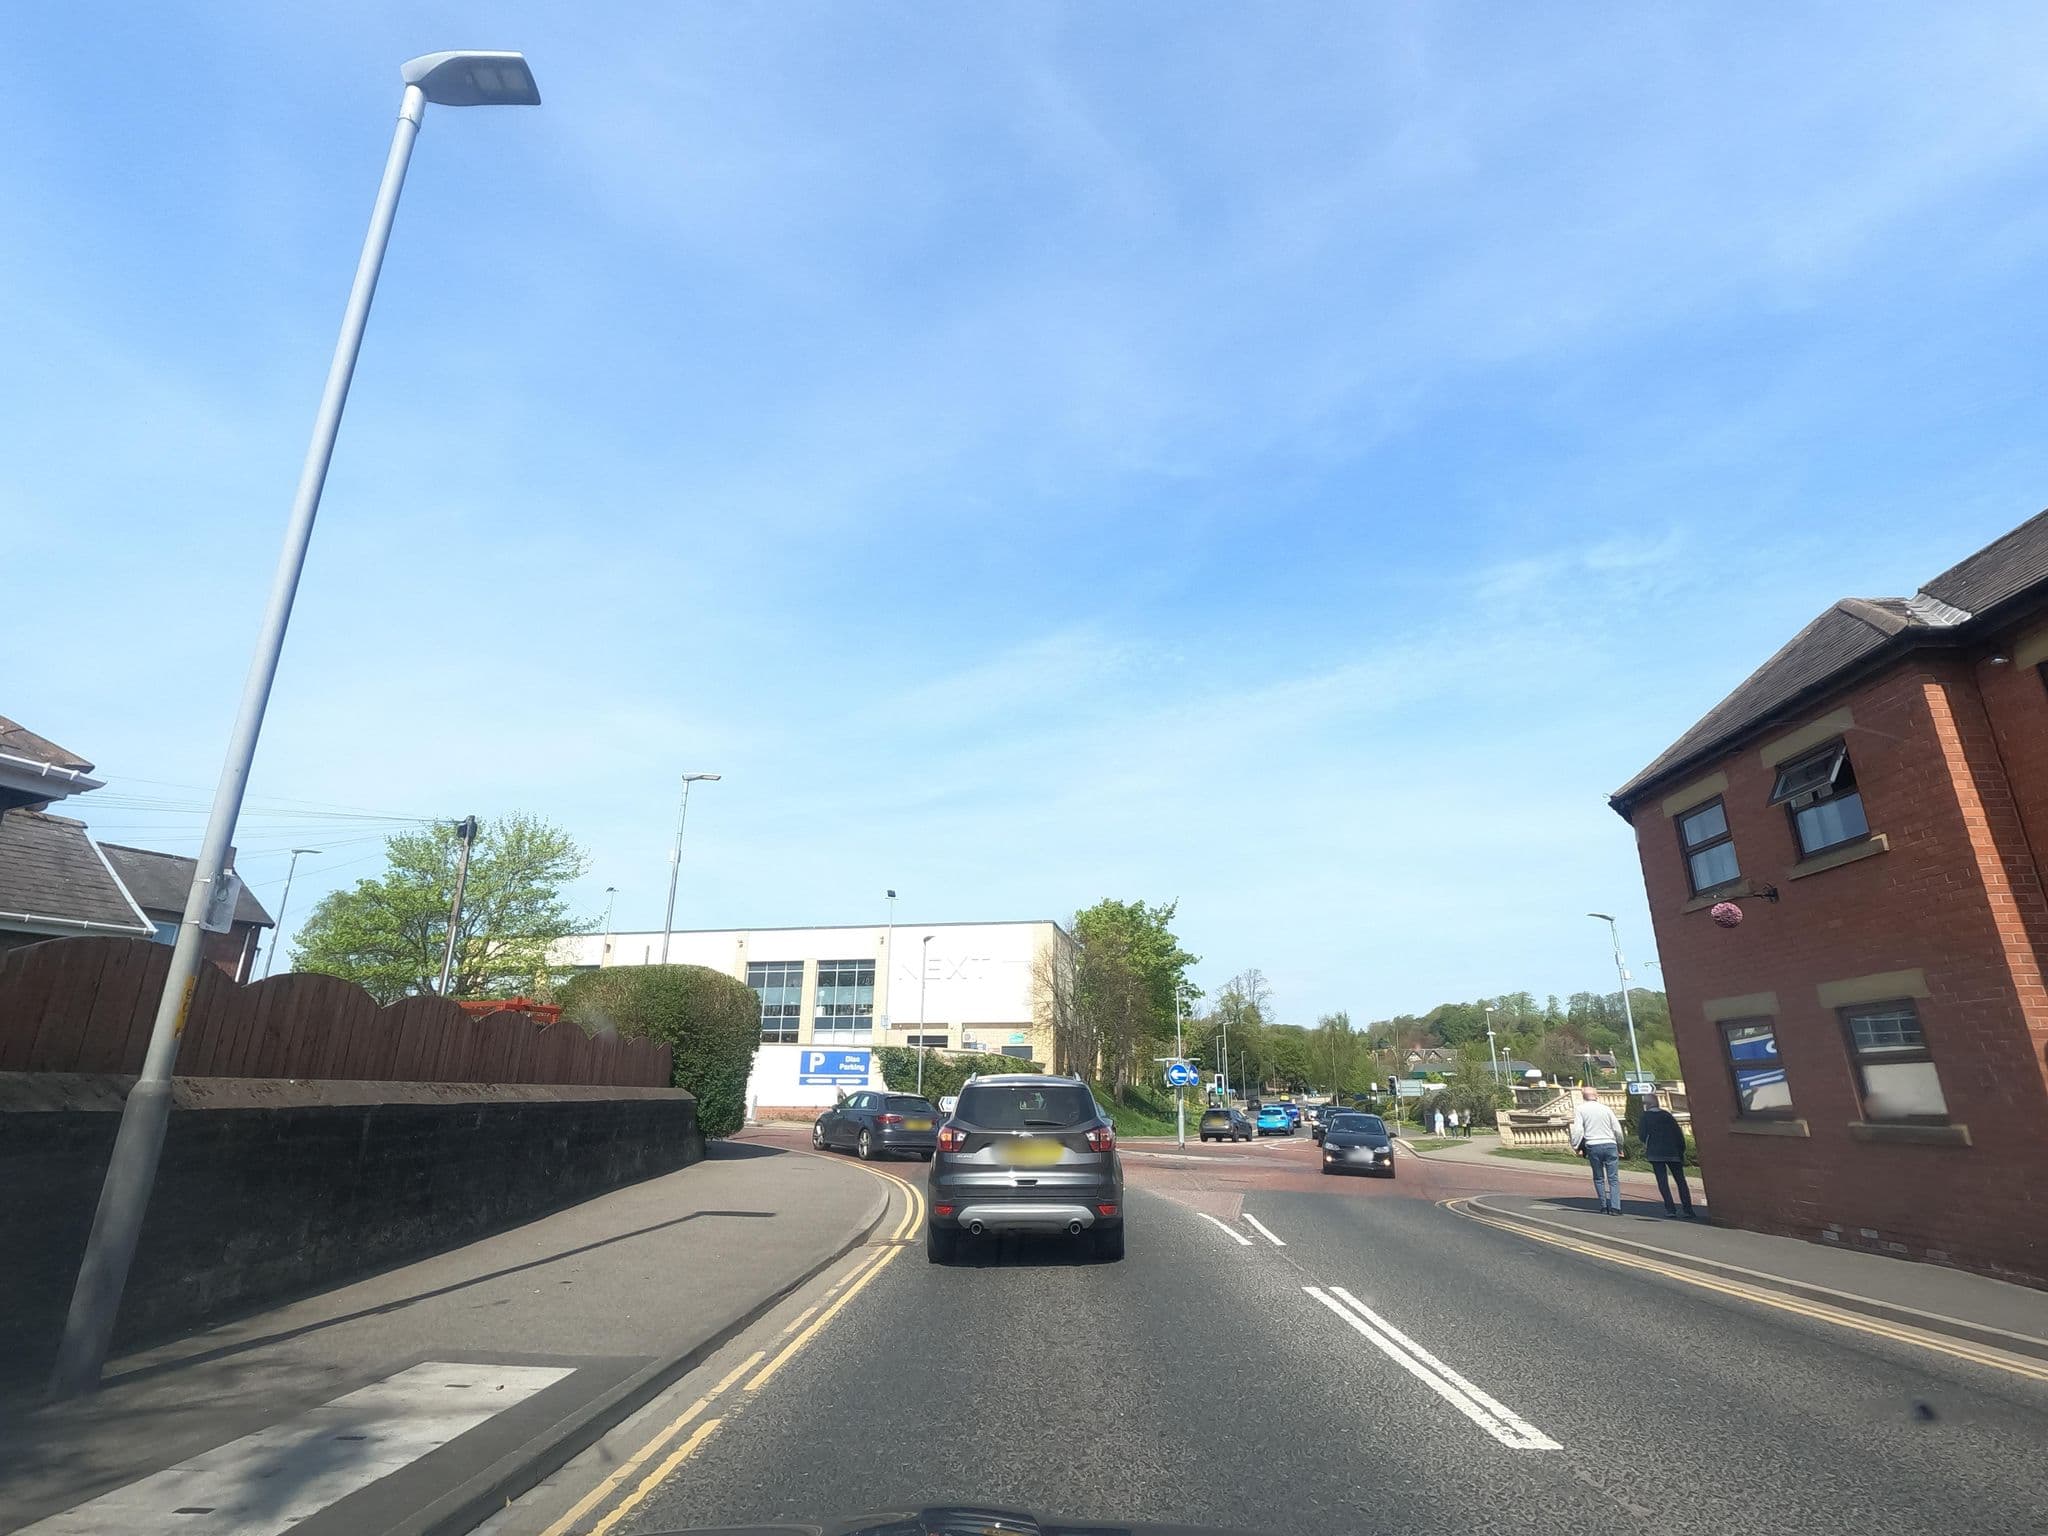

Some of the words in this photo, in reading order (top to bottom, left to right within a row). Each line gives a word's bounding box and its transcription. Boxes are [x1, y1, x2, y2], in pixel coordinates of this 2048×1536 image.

[898, 956, 992, 981] NEXT
[809, 1052, 826, 1072] P
[839, 1063, 866, 1072] Parking
